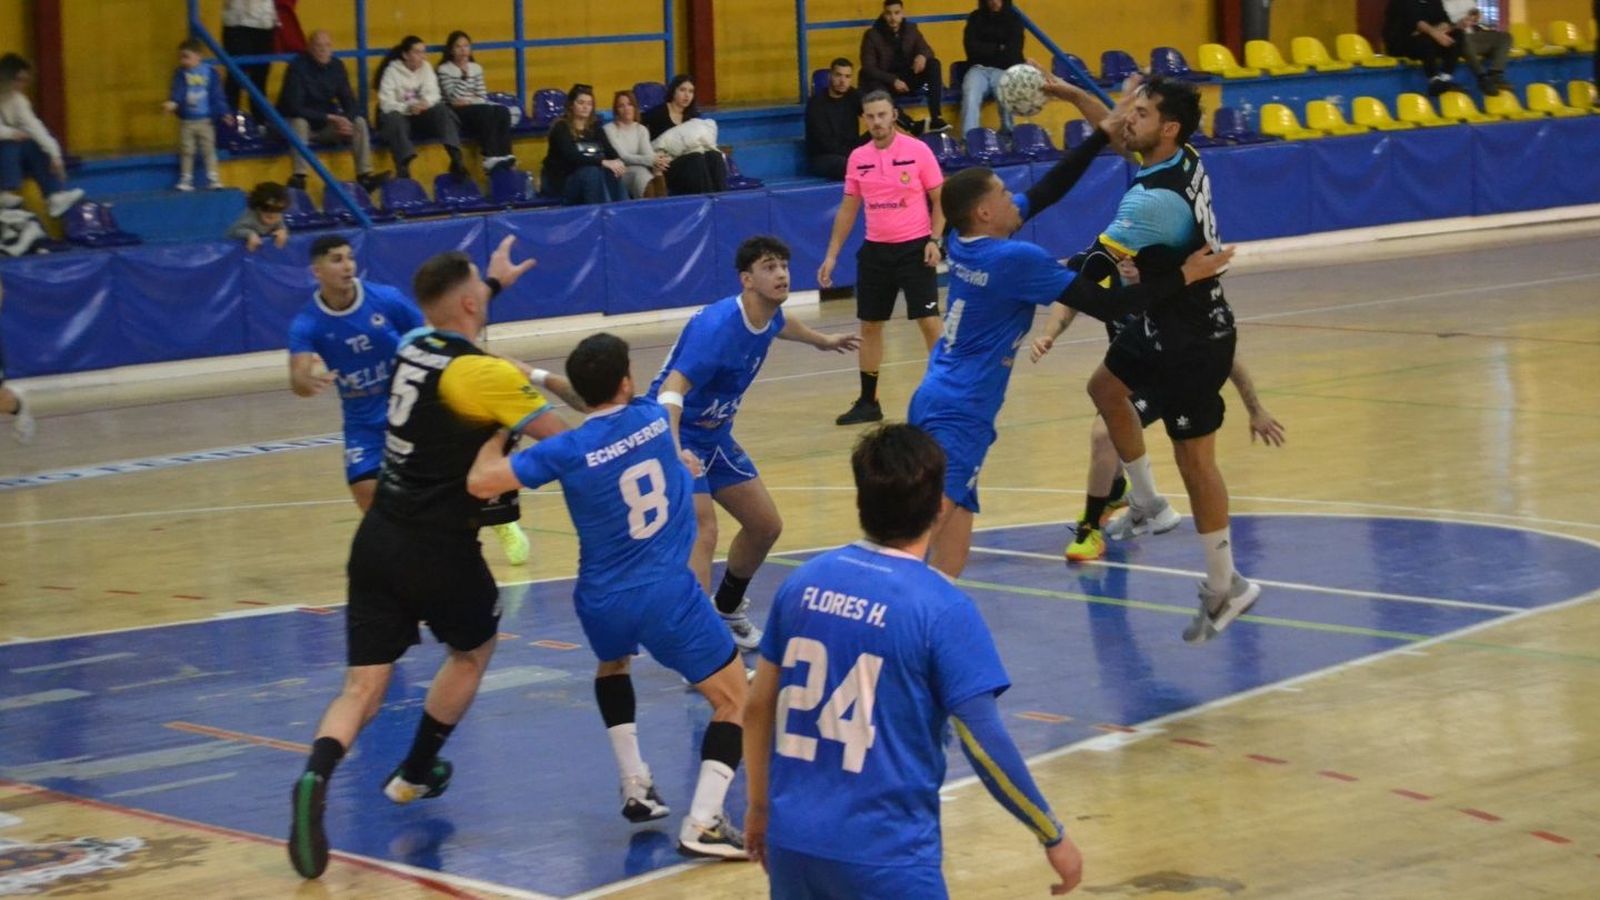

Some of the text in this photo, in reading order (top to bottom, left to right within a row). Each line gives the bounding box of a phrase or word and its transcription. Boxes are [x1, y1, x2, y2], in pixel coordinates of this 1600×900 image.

[344, 334, 373, 354] 72
[387, 360, 430, 427] 5
[618, 458, 670, 540] 8
[801, 586, 887, 628] FLORES H.
[775, 636, 884, 774] 24
